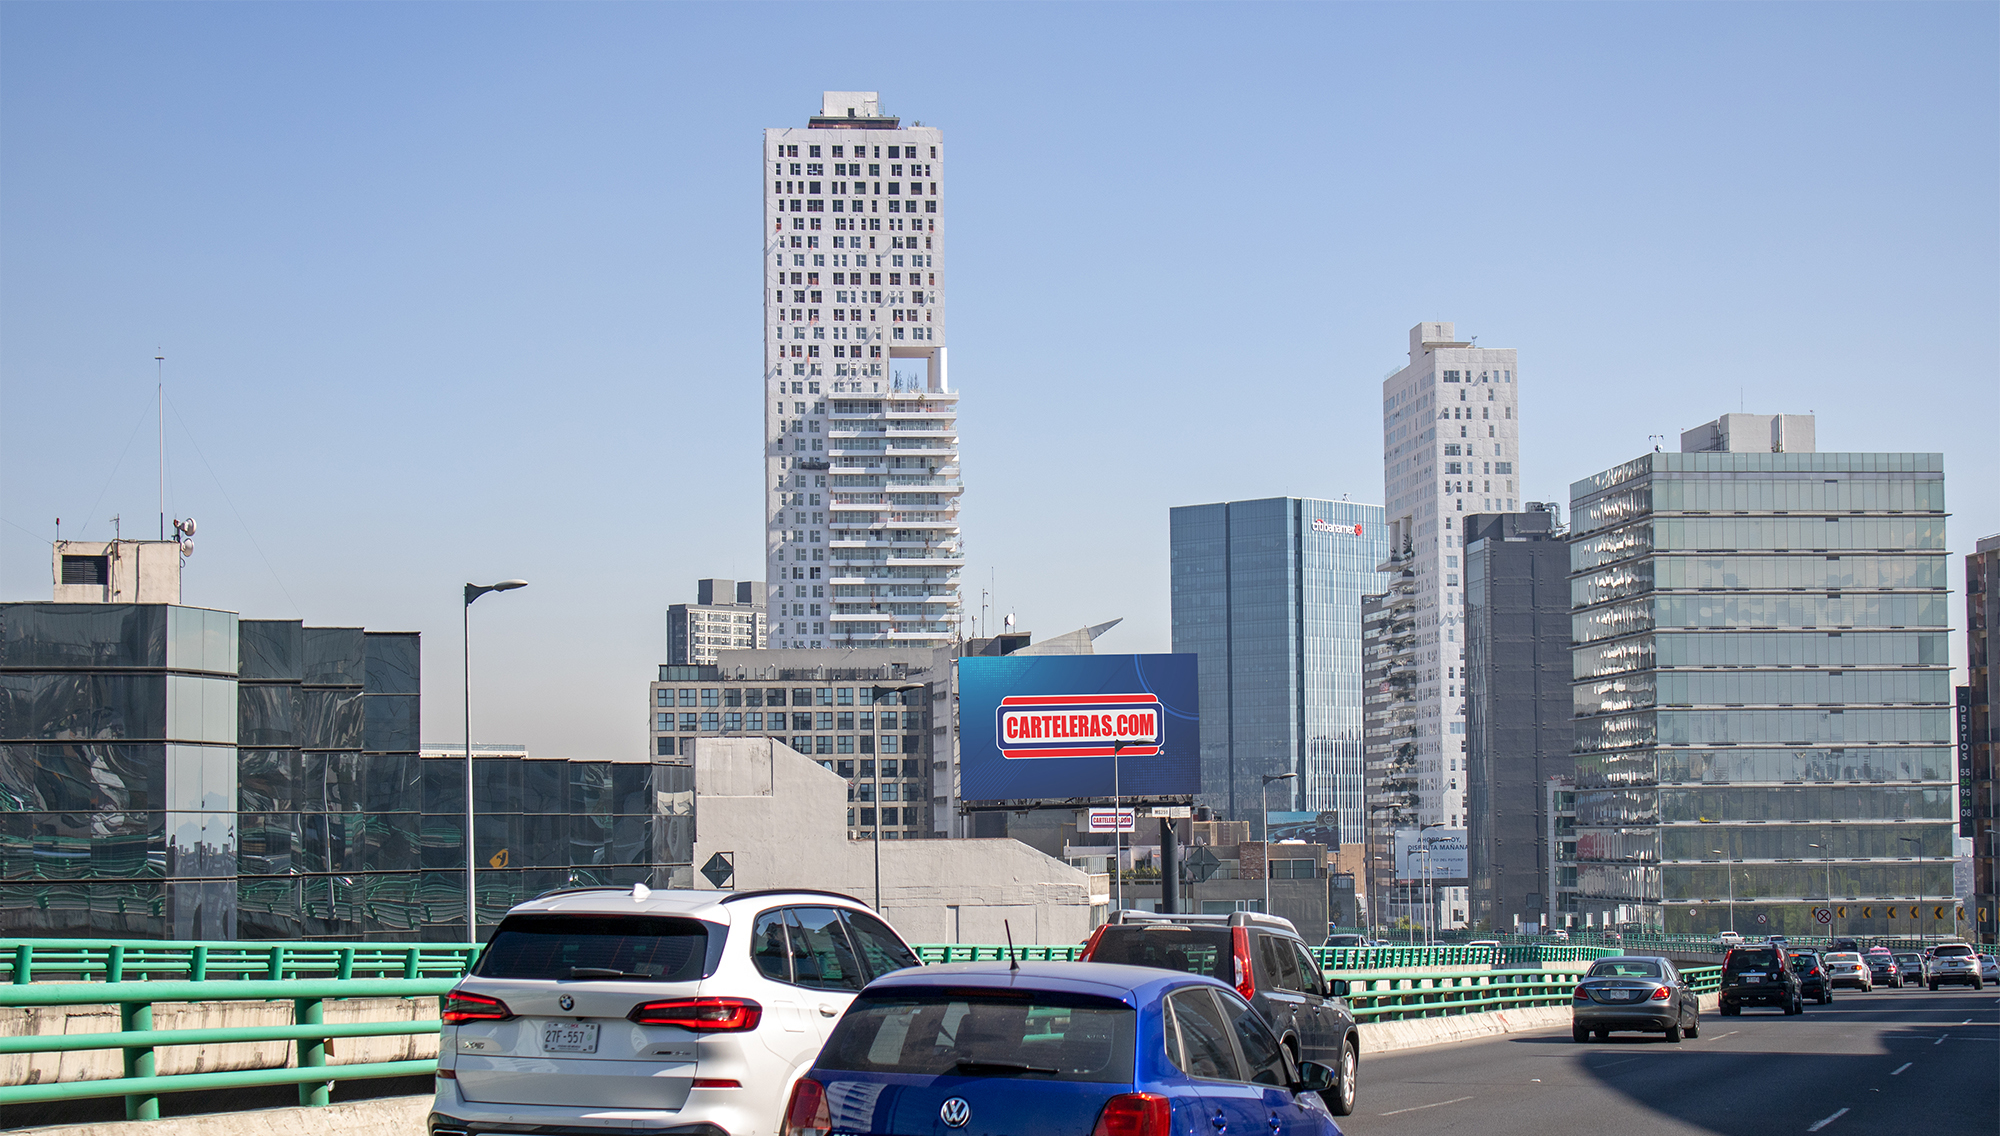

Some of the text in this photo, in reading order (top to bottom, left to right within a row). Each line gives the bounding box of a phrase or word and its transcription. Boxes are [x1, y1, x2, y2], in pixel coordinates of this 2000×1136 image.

[1311, 520, 1357, 535] citibanamex
[1006, 713, 1154, 739] CARTELERAS.COM
[1960, 705, 1969, 761] DEPTOS
[1960, 768, 1971, 777] 55
[1960, 778, 1971, 787] 55
[1960, 788, 1971, 797] 95
[1961, 799, 1970, 807] 21
[1960, 809, 1972, 817] 08
[545, 1030, 585, 1044] 27F-557
